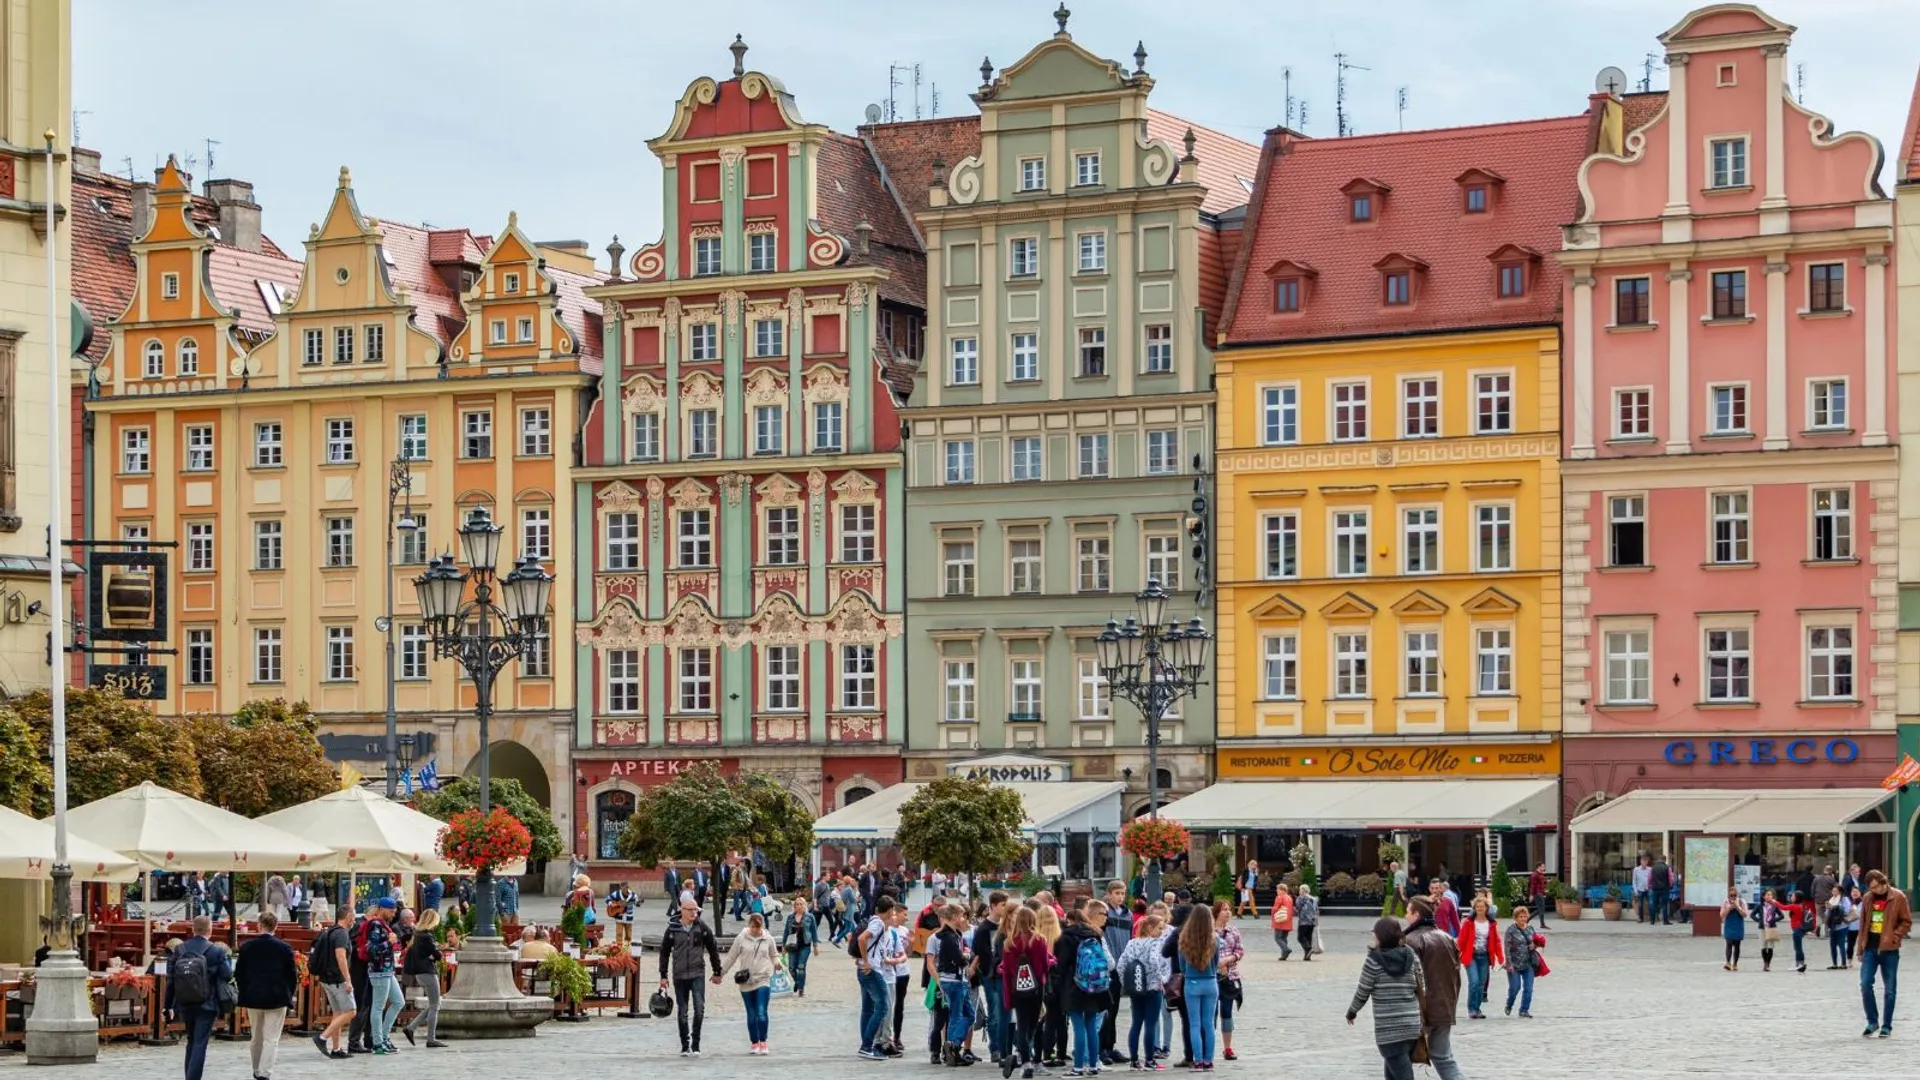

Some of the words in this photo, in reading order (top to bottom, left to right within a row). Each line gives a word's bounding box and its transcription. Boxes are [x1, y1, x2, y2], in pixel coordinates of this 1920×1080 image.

[1230, 757, 1291, 768] RISTORANTE
[1356, 748, 1406, 774] Sole
[1408, 748, 1460, 772] Mio
[1498, 754, 1545, 764] PIZZERIA
[1664, 739, 1859, 765] GRECO
[1134, 965, 1142, 991] adidas
